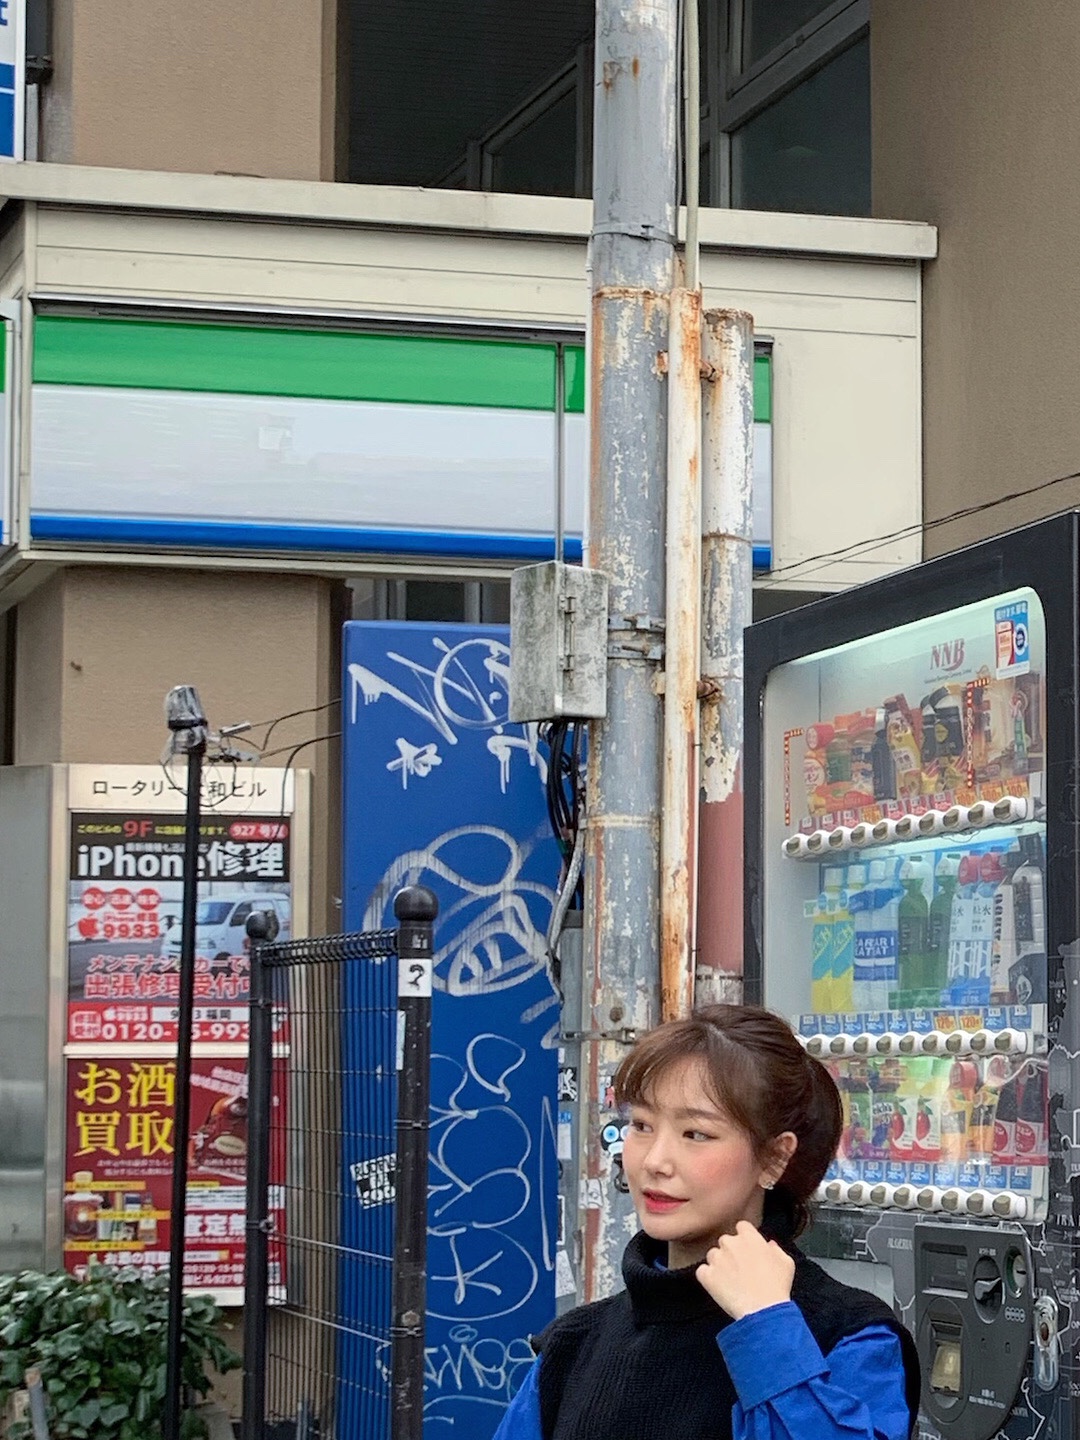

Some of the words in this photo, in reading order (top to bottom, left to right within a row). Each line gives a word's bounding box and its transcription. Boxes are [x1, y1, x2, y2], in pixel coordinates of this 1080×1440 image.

[930, 638, 965, 671] NNB
[122, 820, 153, 838] 9F
[233, 824, 256, 838] 927
[75, 1062, 177, 1107] お酒
[74, 1110, 175, 1157] 買取
